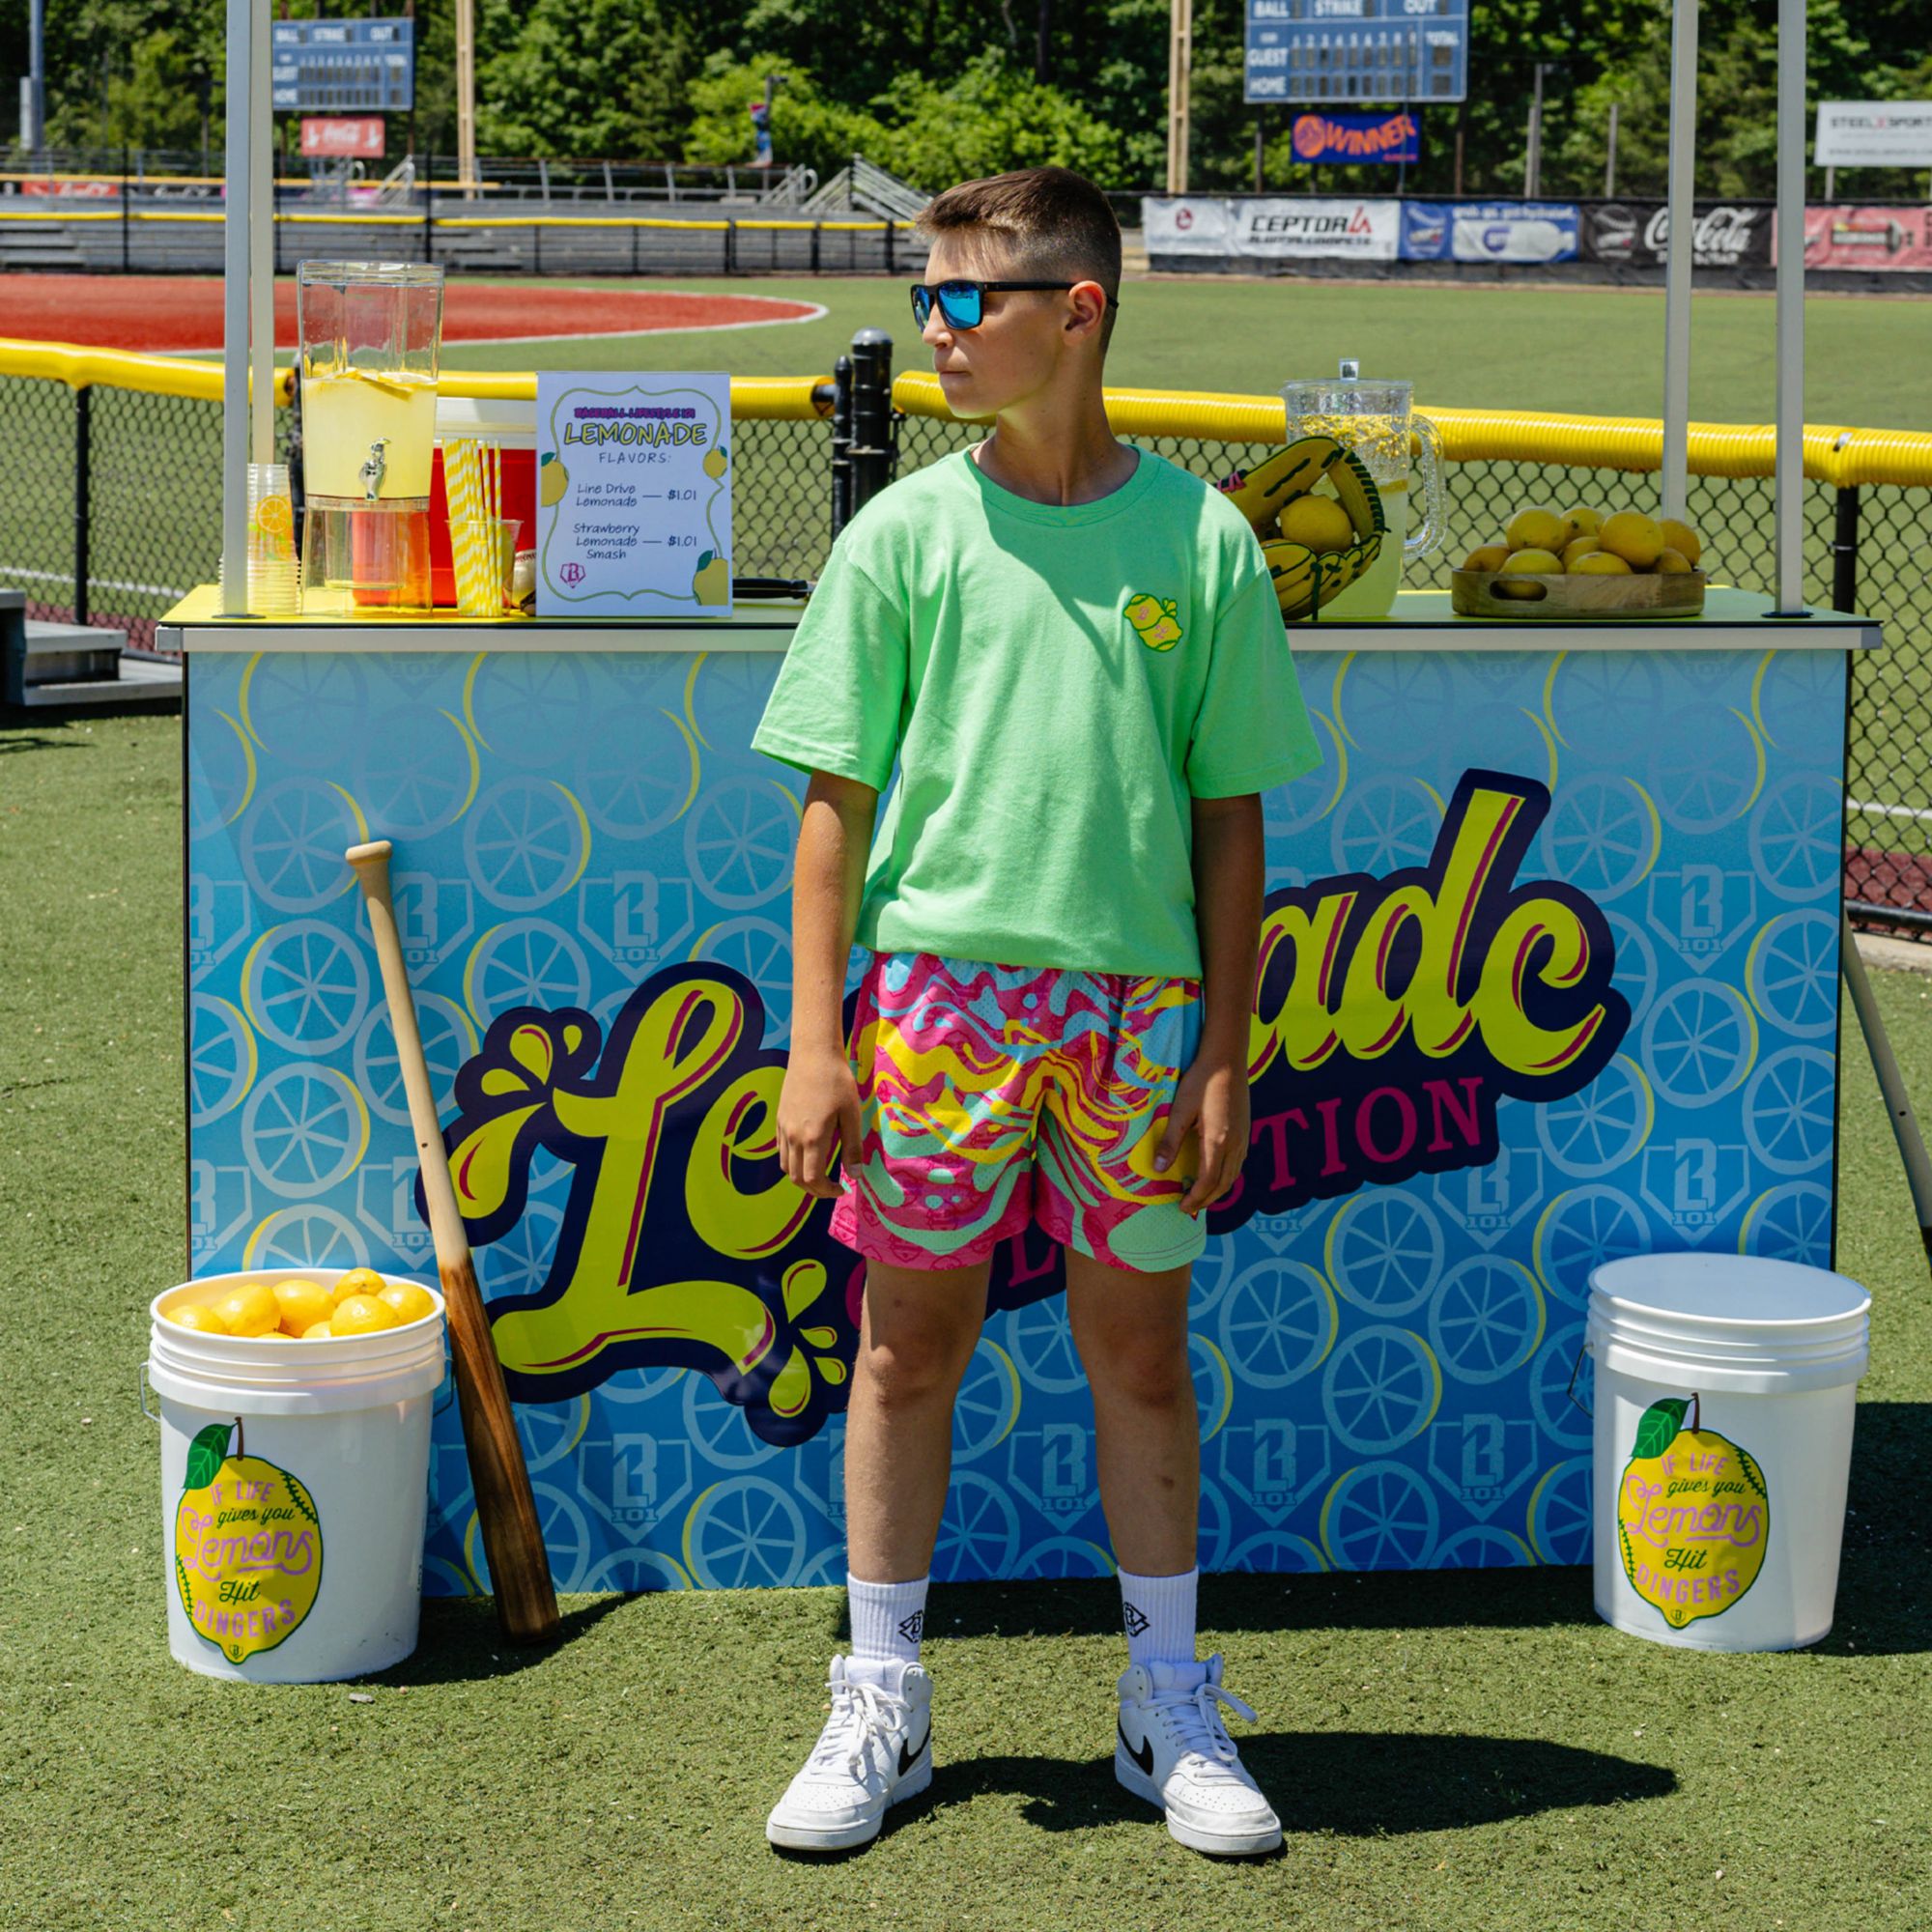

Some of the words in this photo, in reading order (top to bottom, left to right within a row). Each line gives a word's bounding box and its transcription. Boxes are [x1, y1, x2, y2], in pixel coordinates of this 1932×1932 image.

[1247, 47, 1289, 68] GUEST
[1249, 75, 1287, 95] HOME
[1326, 113, 1416, 156] WINNER
[563, 421, 708, 449] LEMONADE
[577, 484, 603, 495] Line
[606, 483, 636, 495] Drive
[668, 490, 697, 501] $1.01
[576, 496, 638, 509] Lemonade
[573, 523, 640, 536] Strawberry
[576, 535, 638, 548] Lemonade
[668, 535, 697, 548] $1.01
[586, 549, 627, 560] Smash
[613, 870, 660, 949] B
[1679, 864, 1723, 937] B
[612, 948, 662, 963] 101
[1678, 938, 1725, 953] 101
[1673, 1138, 1718, 1213] B
[1255, 1216, 1306, 1234] 101
[1463, 1214, 1514, 1231] 101
[1671, 1212, 1719, 1228] 101
[1042, 1423, 1088, 1497] B
[1252, 1418, 1297, 1492] B
[1461, 1413, 1506, 1489] B
[612, 1434, 659, 1508] B
[1661, 1453, 1677, 1477] IF
[1689, 1453, 1729, 1476] LIFE
[210, 1482, 224, 1507] IF
[235, 1479, 276, 1504] LIFE
[1251, 1492, 1298, 1507] 101
[1460, 1487, 1507, 1502] 101
[1665, 1478, 1710, 1499] gives
[1712, 1478, 1747, 1498] you
[611, 1508, 660, 1523] 101
[1039, 1497, 1089, 1513] 101
[1625, 1473, 1763, 1548] Lemons
[216, 1505, 260, 1530] gives
[260, 1506, 297, 1527] you
[181, 1505, 314, 1583] Lemons
[1663, 1548, 1709, 1573] Hit
[218, 1579, 263, 1606] Hit
[1635, 1563, 1741, 1605] DINGERS
[193, 1599, 297, 1640] DINGERS
